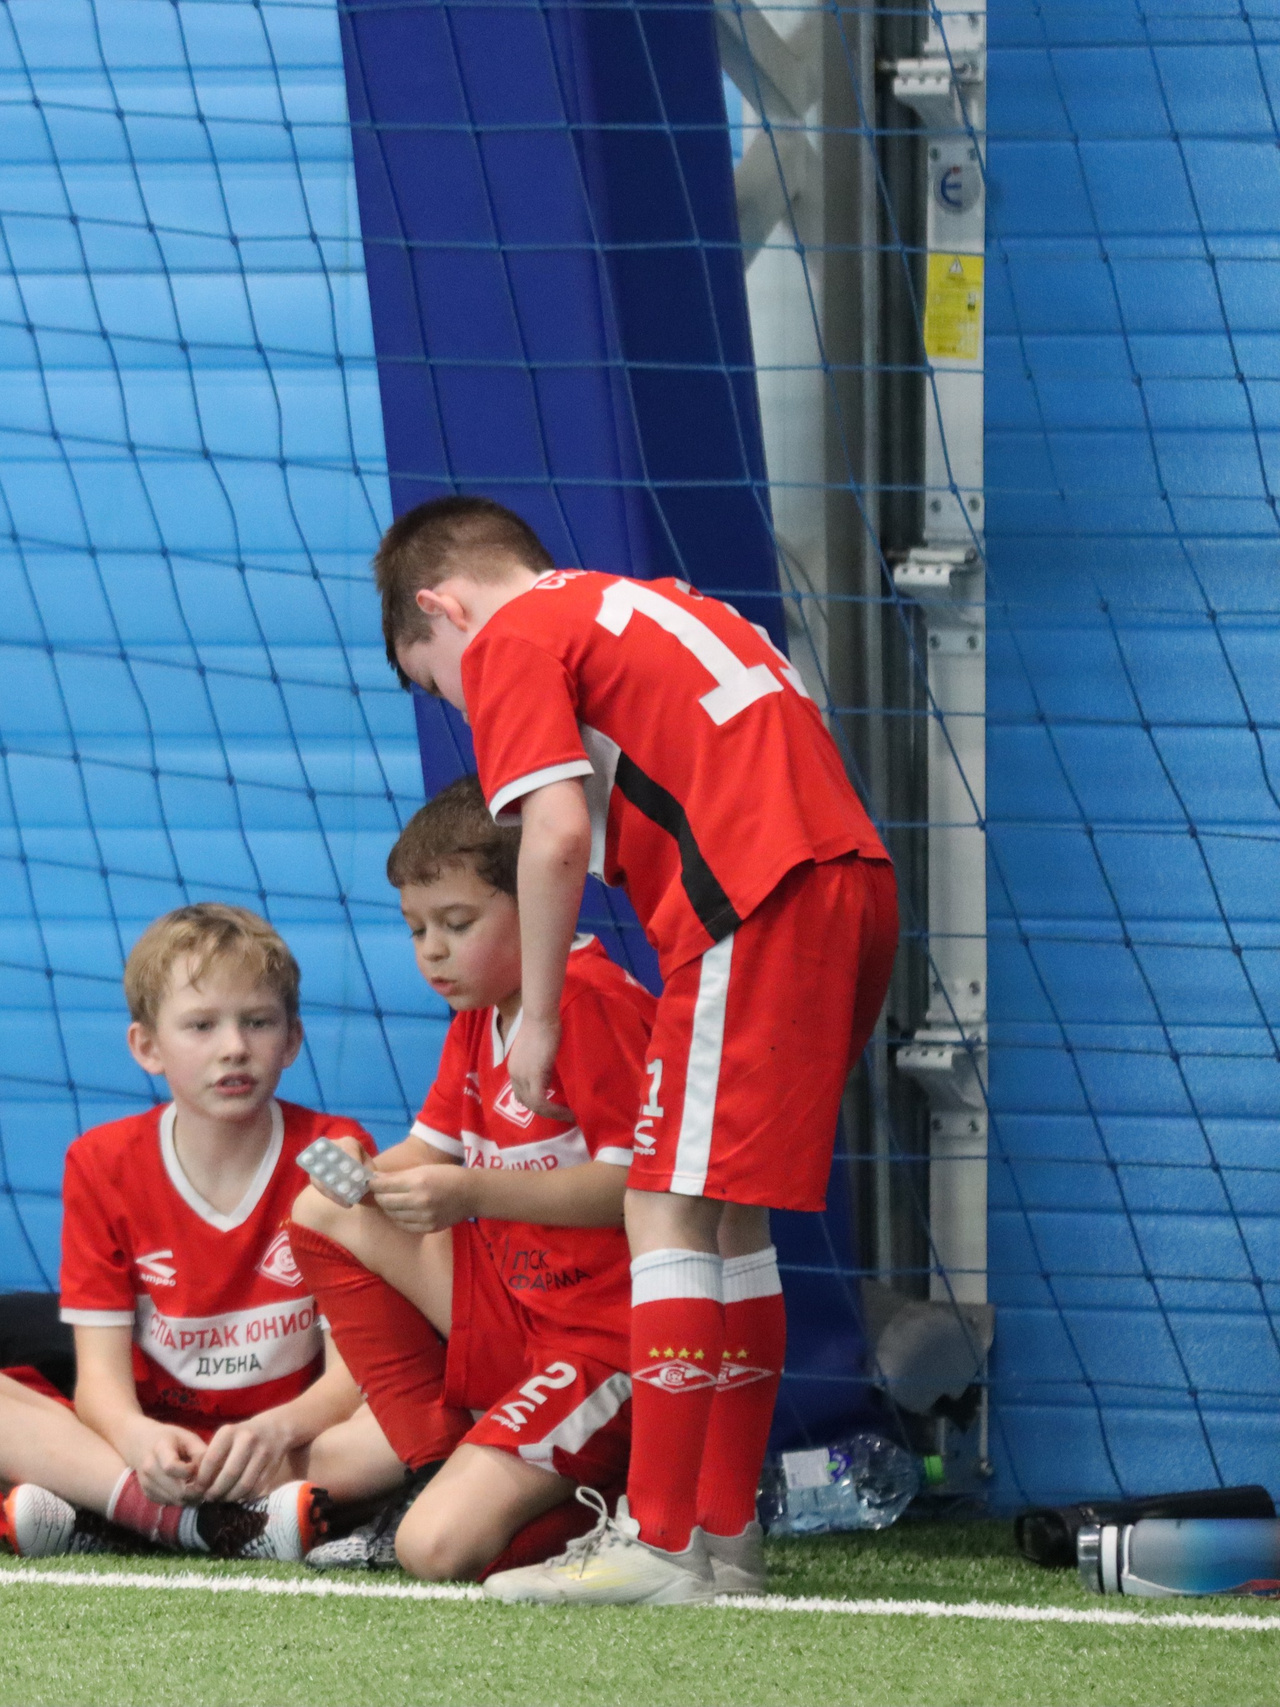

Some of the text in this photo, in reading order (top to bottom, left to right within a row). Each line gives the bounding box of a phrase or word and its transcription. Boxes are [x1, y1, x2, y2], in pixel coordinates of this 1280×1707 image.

[596, 578, 811, 727] 1
[513, 1250, 551, 1271] ПСК
[508, 1266, 593, 1292] ФАРМА
[150, 1312, 240, 1351] СПАРТАК
[196, 1353, 263, 1377] ДУБНА
[518, 1361, 577, 1406] 2
